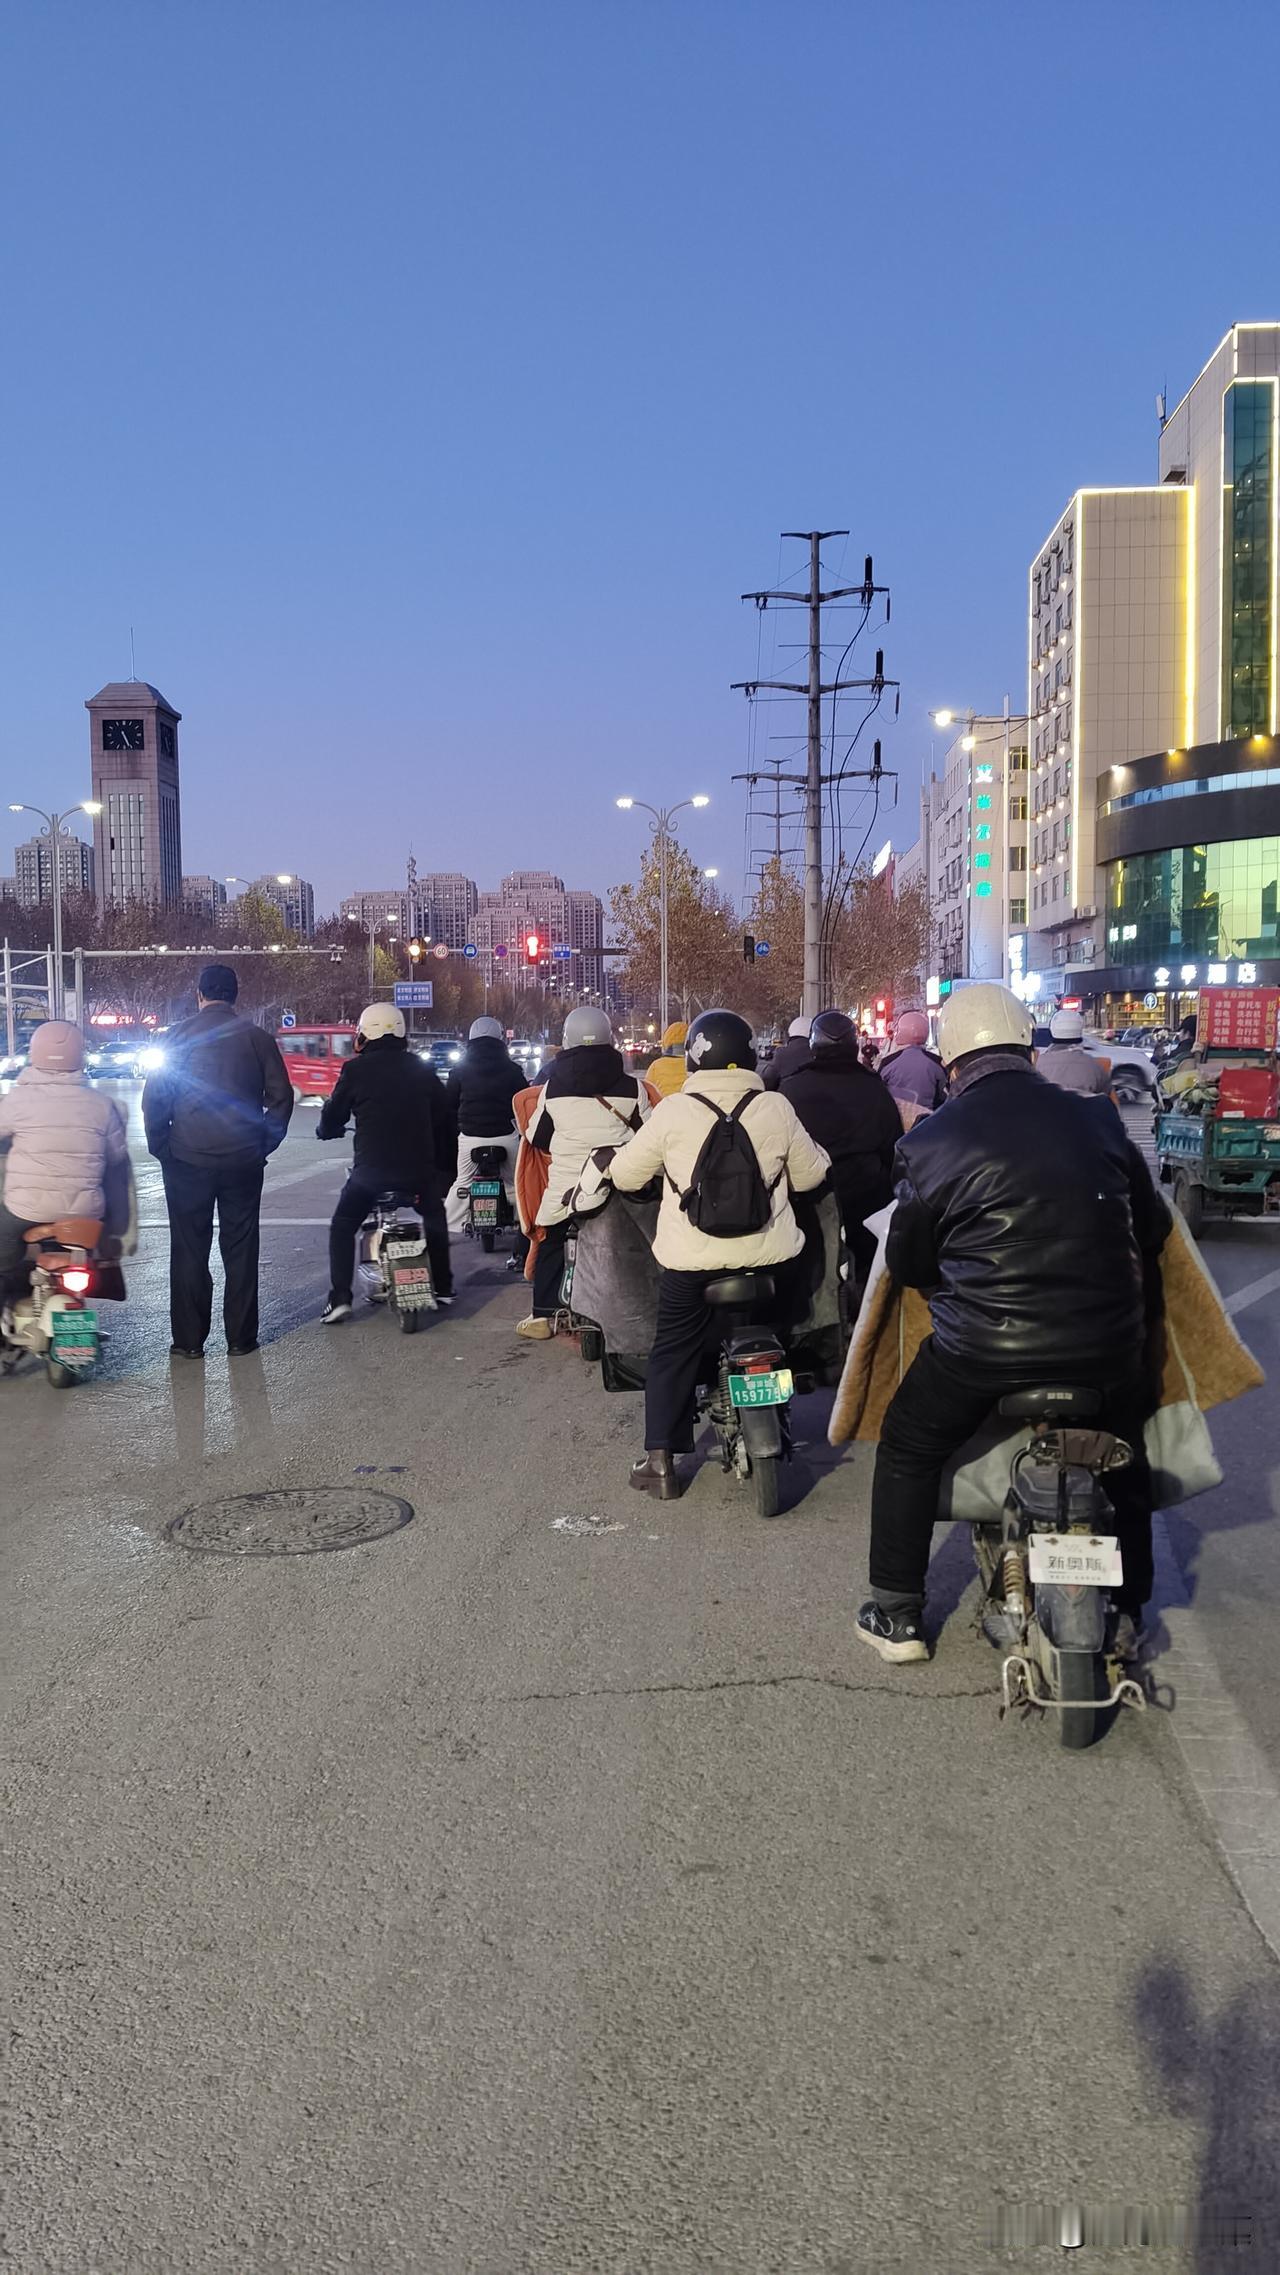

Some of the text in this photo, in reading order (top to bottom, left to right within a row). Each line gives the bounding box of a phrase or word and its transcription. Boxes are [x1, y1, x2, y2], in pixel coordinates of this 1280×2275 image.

[1154, 962, 1256, 987] 全季酒店
[1237, 1001, 1261, 1009] 摩托车
[1237, 1010, 1261, 1018] 洗衣机
[1199, 997, 1210, 1042] 酒店用品
[1236, 1028, 1259, 1036] 自行车
[1235, 1036, 1259, 1045] 三轮车
[1048, 1556, 1103, 1571] 新奥斯
